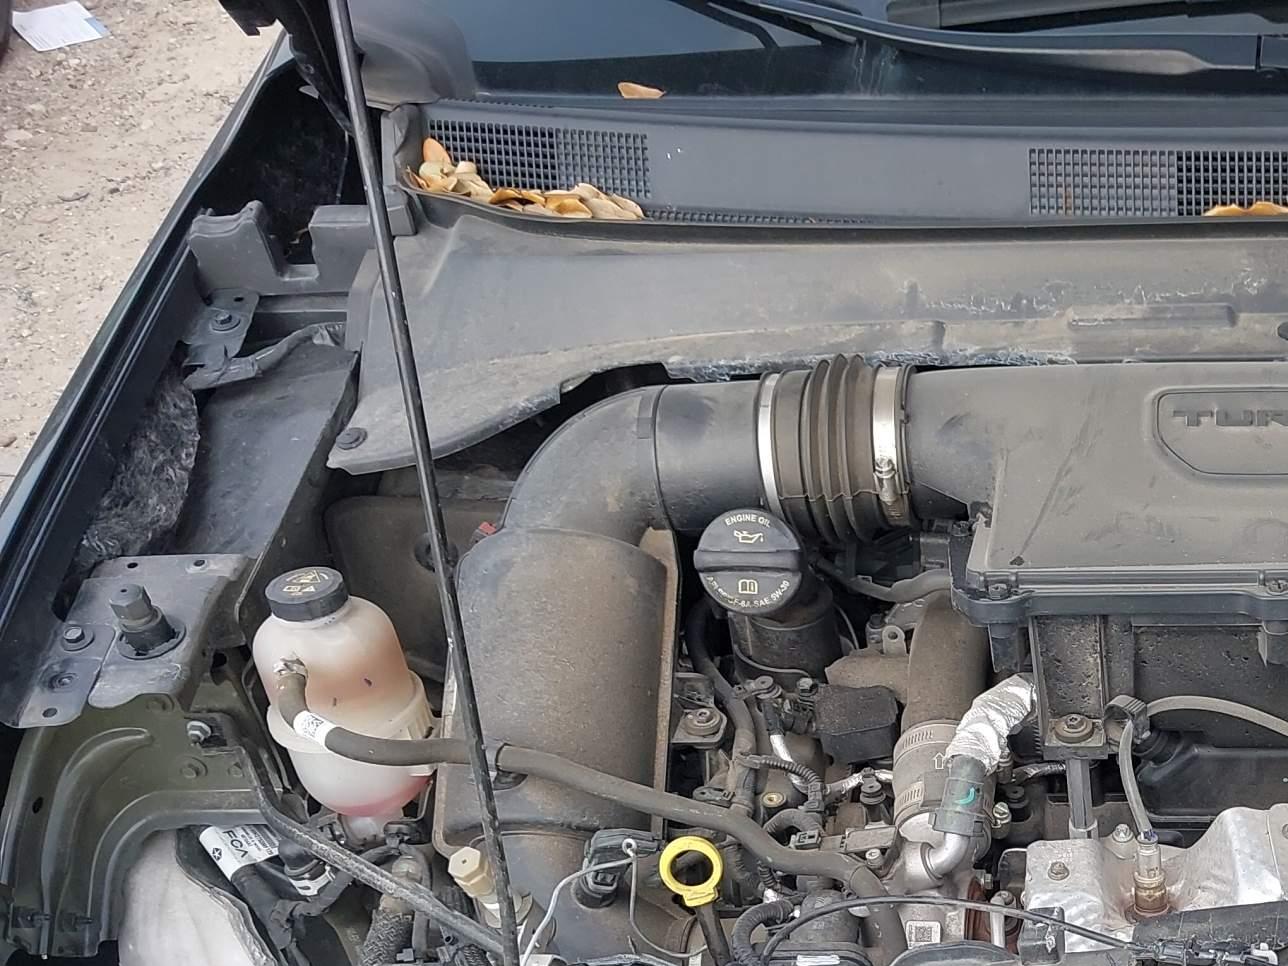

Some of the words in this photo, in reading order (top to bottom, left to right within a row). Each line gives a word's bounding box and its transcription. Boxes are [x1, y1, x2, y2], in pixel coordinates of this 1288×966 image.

[724, 513, 757, 526] ENGINE
[758, 516, 771, 528] OIL
[753, 597, 770, 608] SAE
[770, 579, 790, 601] 5W-30
[222, 829, 249, 858] FCA
